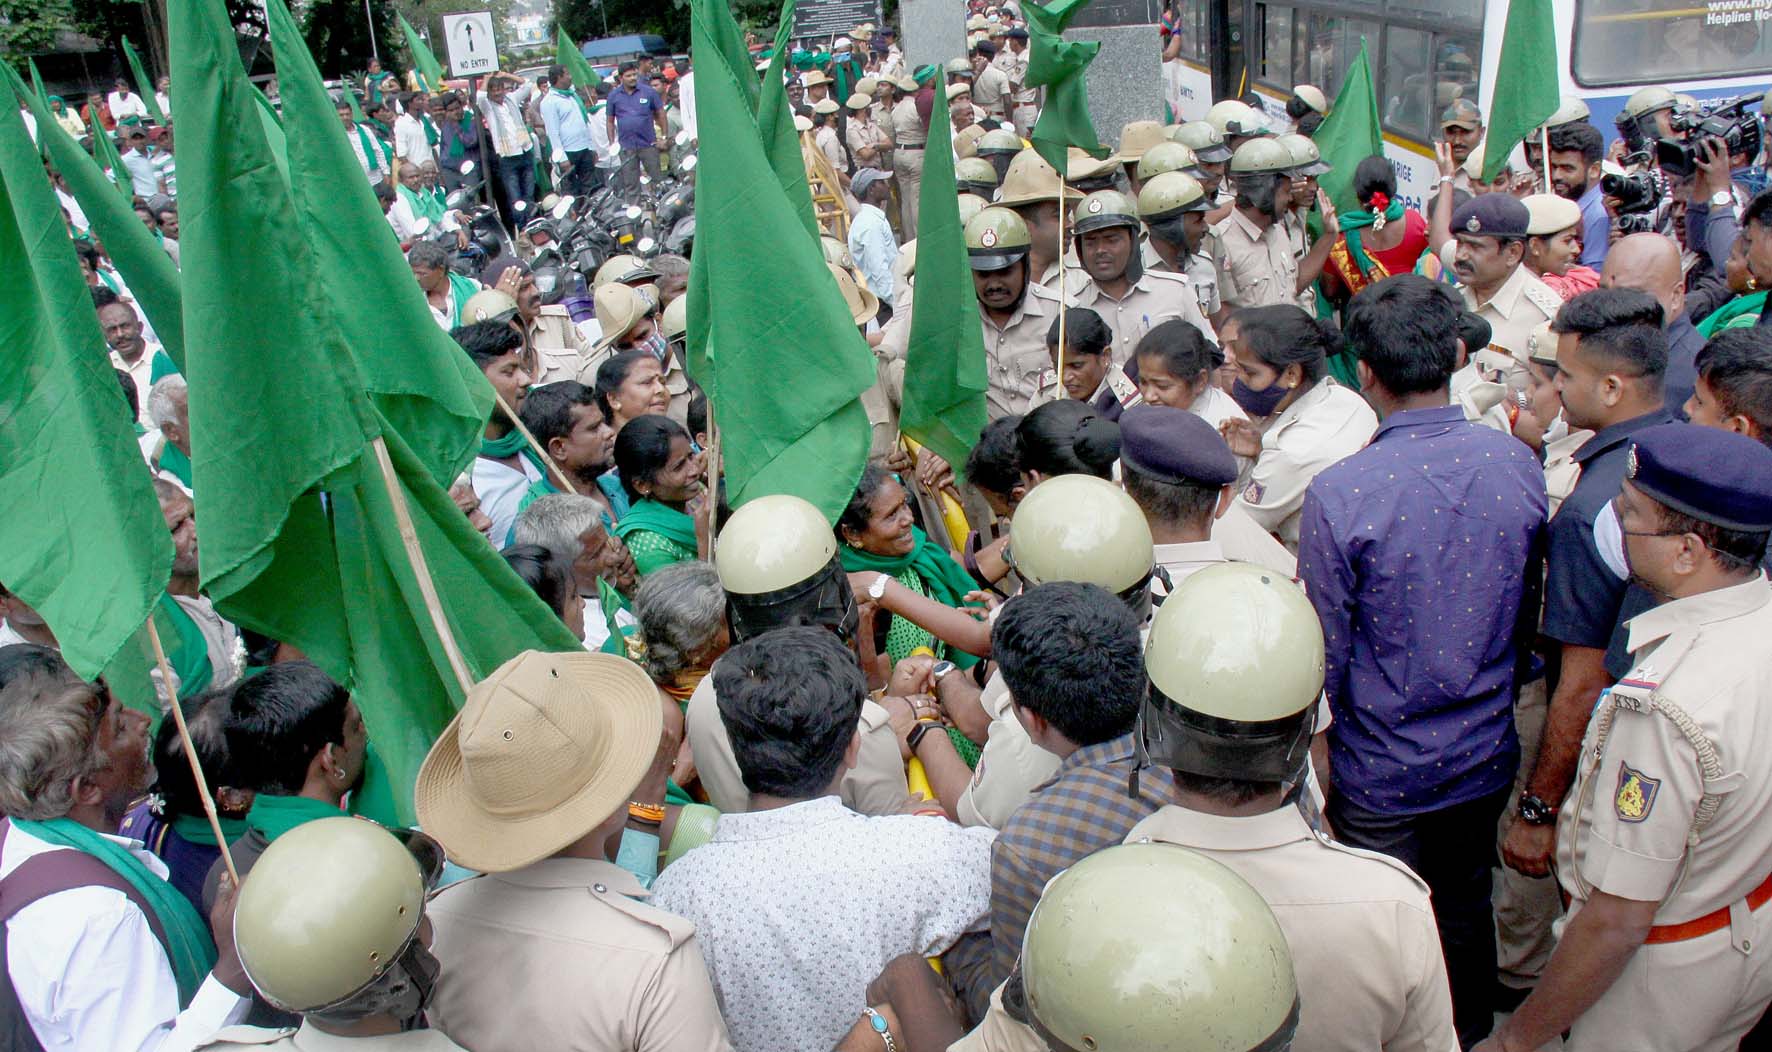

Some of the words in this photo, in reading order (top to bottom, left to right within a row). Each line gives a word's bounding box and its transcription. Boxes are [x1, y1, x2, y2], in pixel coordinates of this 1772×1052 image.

[1707, 11, 1752, 27] Helpline
[460, 60, 469, 69] NO
[471, 59, 489, 68] ENTRY
